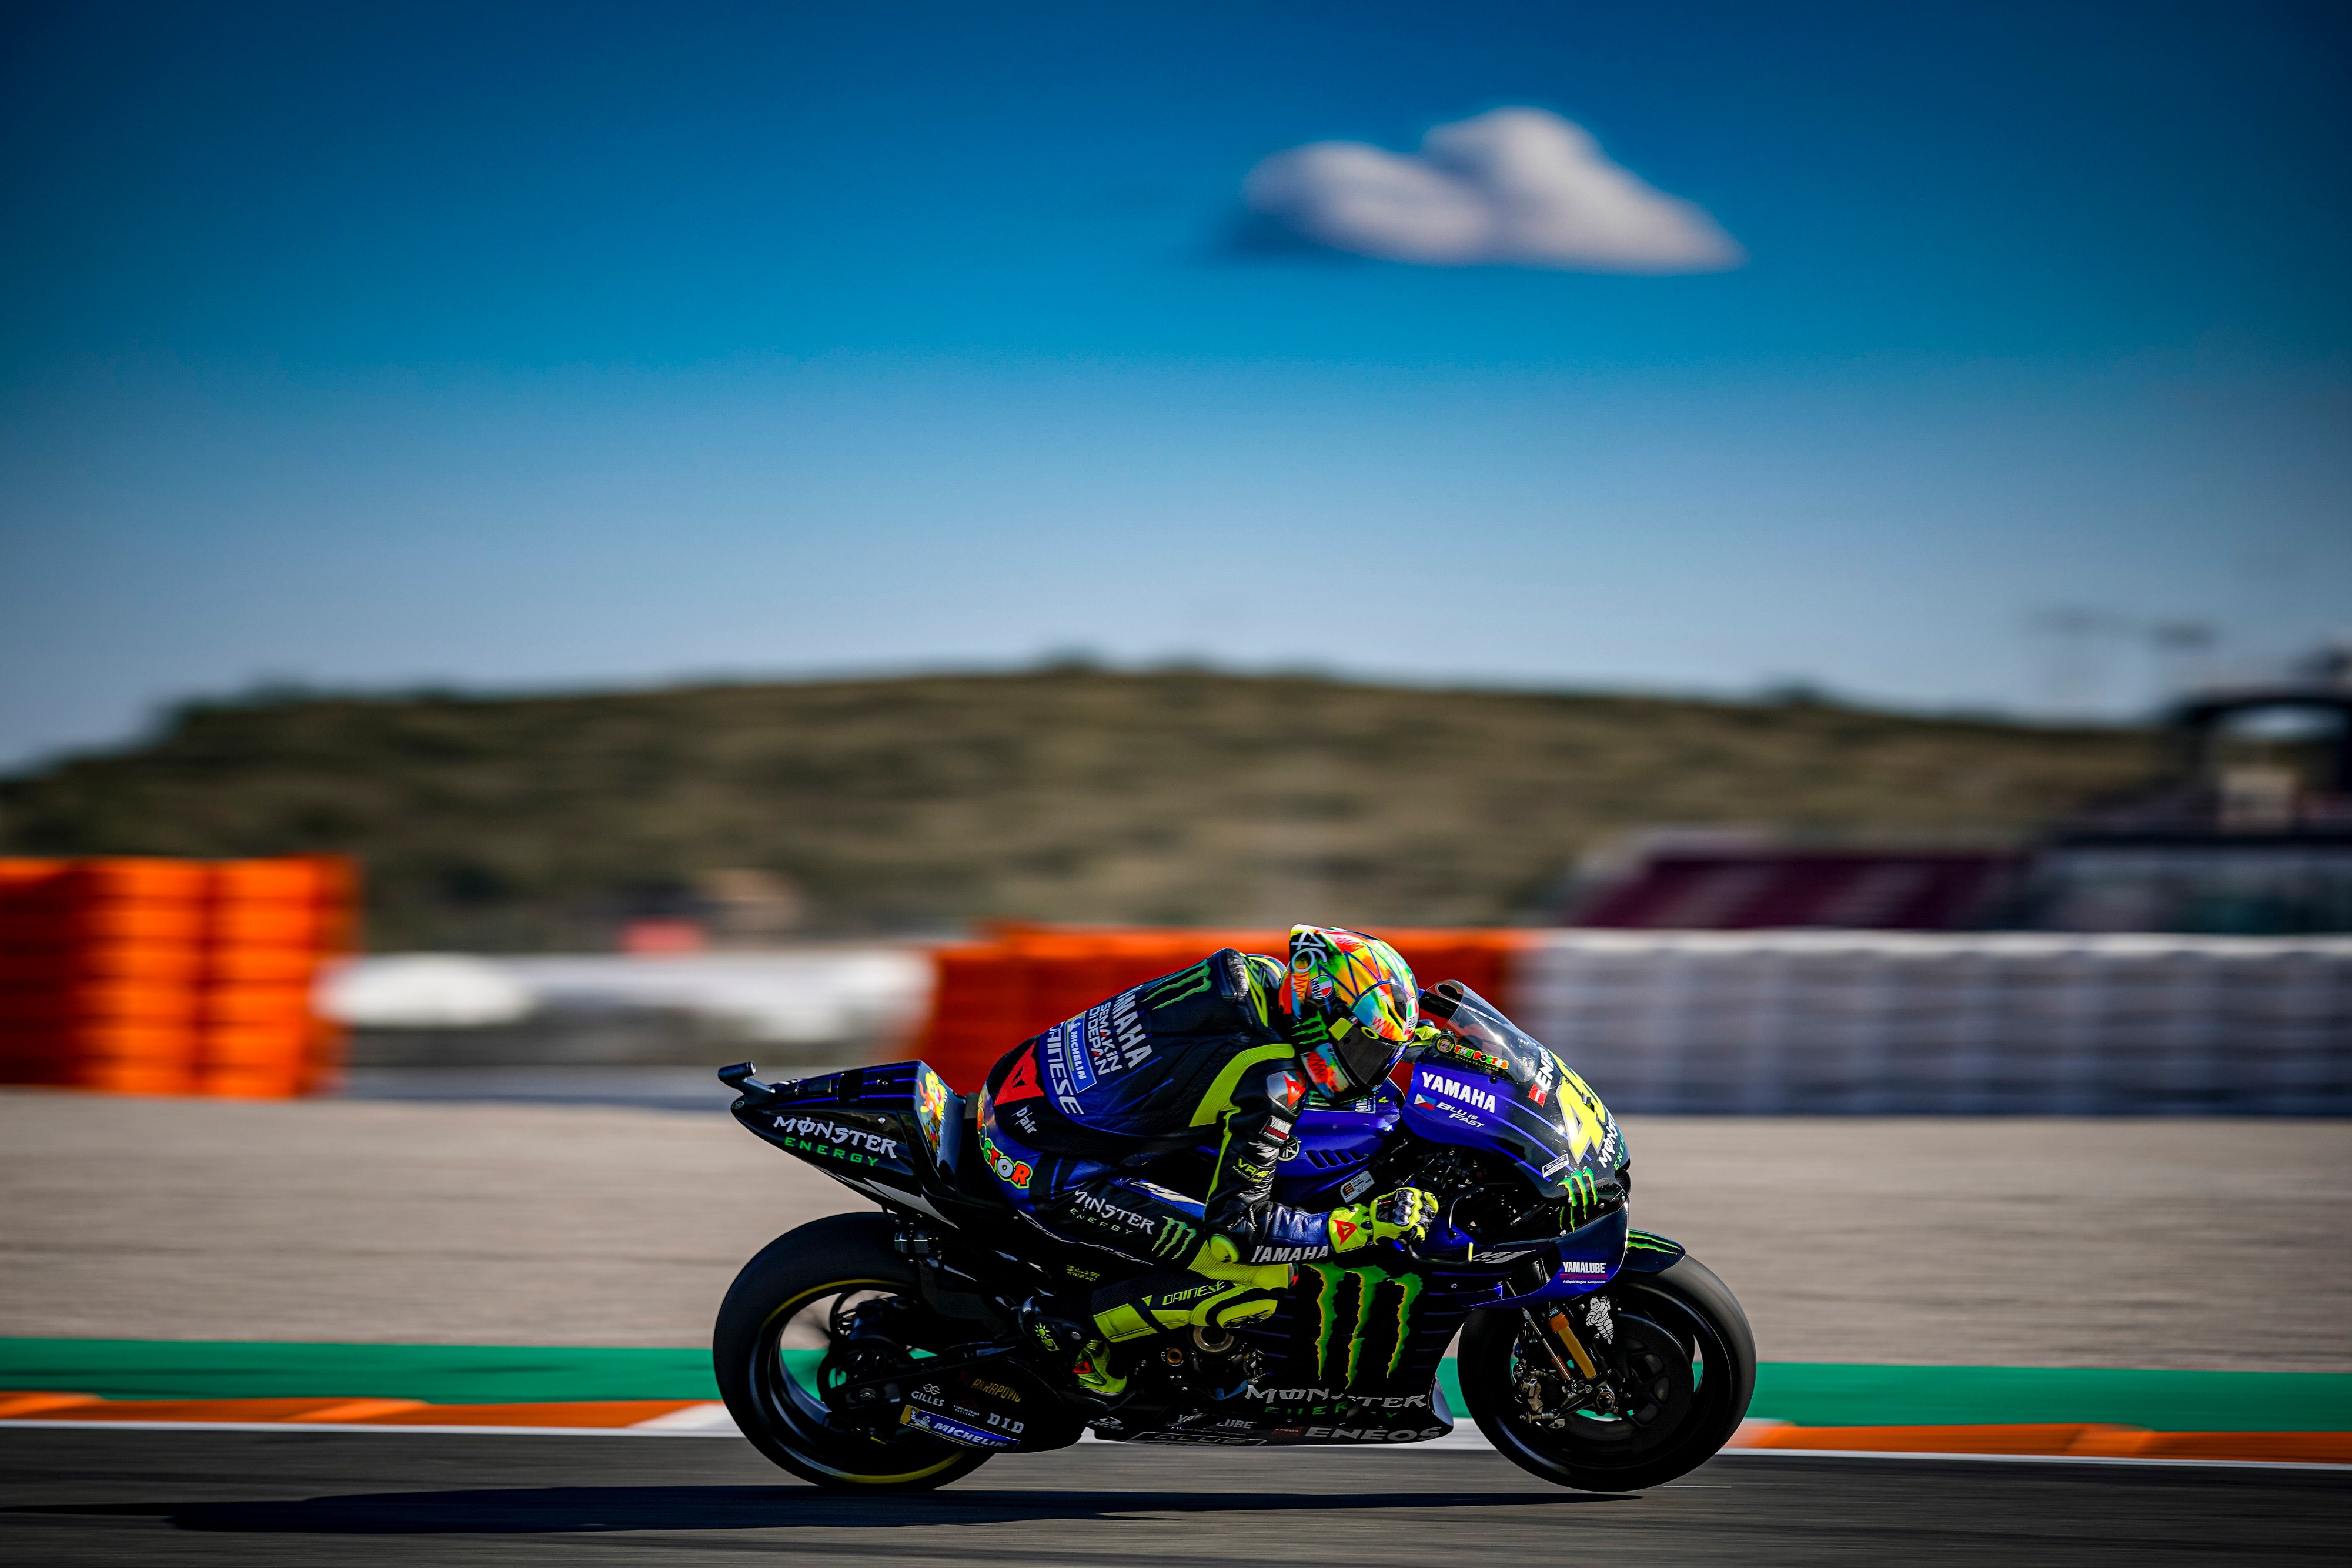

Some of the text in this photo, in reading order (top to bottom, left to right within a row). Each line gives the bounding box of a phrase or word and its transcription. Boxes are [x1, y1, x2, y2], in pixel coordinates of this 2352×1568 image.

[1070, 1032, 1087, 1080] MICHELIN
[1454, 1045, 1509, 1070] THE DOCTOR
[1422, 1071, 1495, 1114] YAMAHA
[1436, 1102, 1468, 1116] BLU
[1449, 1113, 1485, 1128] FAST
[773, 1116, 897, 1159] MONSTER
[784, 1136, 879, 1166] ENERGY
[1070, 1208, 1134, 1235] ENERGY
[1250, 1245, 1329, 1263] YAMAHA
[1562, 1261, 1606, 1273] YAMALUBE
[1162, 1280, 1225, 1305] DAINESE
[911, 1390, 945, 1407] GILLES
[933, 1423, 1007, 1447] MICHELIN
[1304, 1426, 1442, 1442] ENEOS
